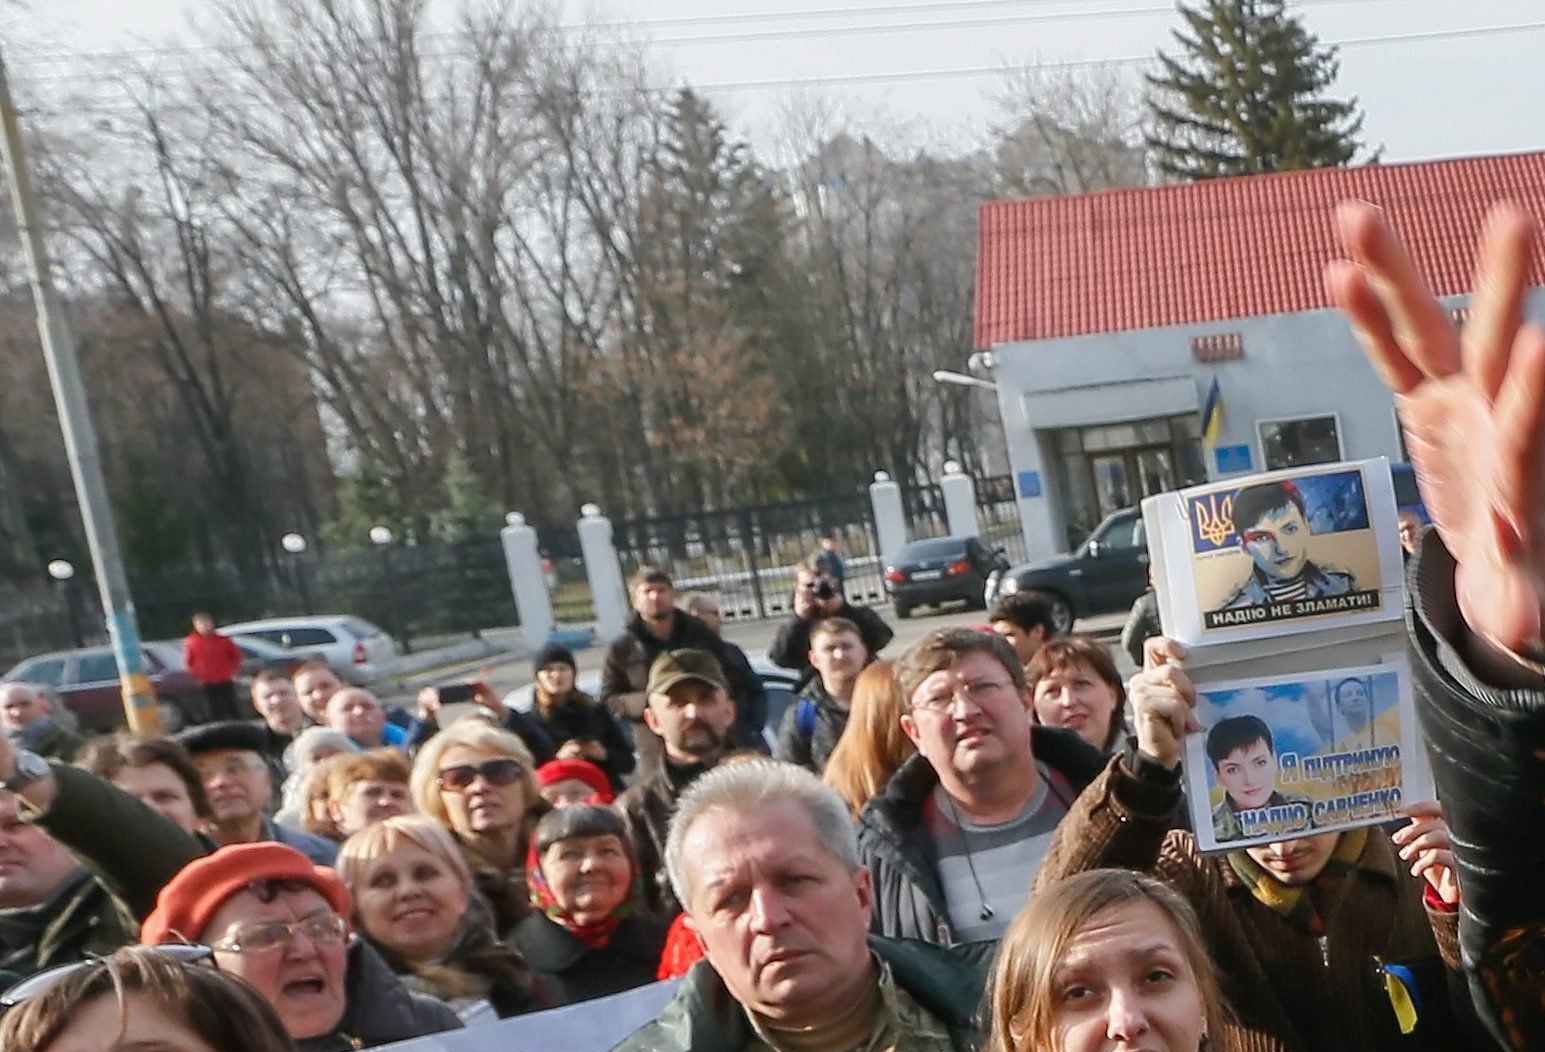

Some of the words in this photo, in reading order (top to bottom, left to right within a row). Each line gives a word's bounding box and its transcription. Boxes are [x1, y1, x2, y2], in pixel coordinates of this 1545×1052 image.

[1212, 607, 1266, 625] НАДІЮ
[1271, 603, 1293, 617] НЕ
[1297, 594, 1373, 614] ЗЛАМАТИ!
[1280, 752, 1299, 784] Я
[1242, 803, 1307, 836] НАДІЮ
[1313, 786, 1402, 825] САВЧЕНКО
